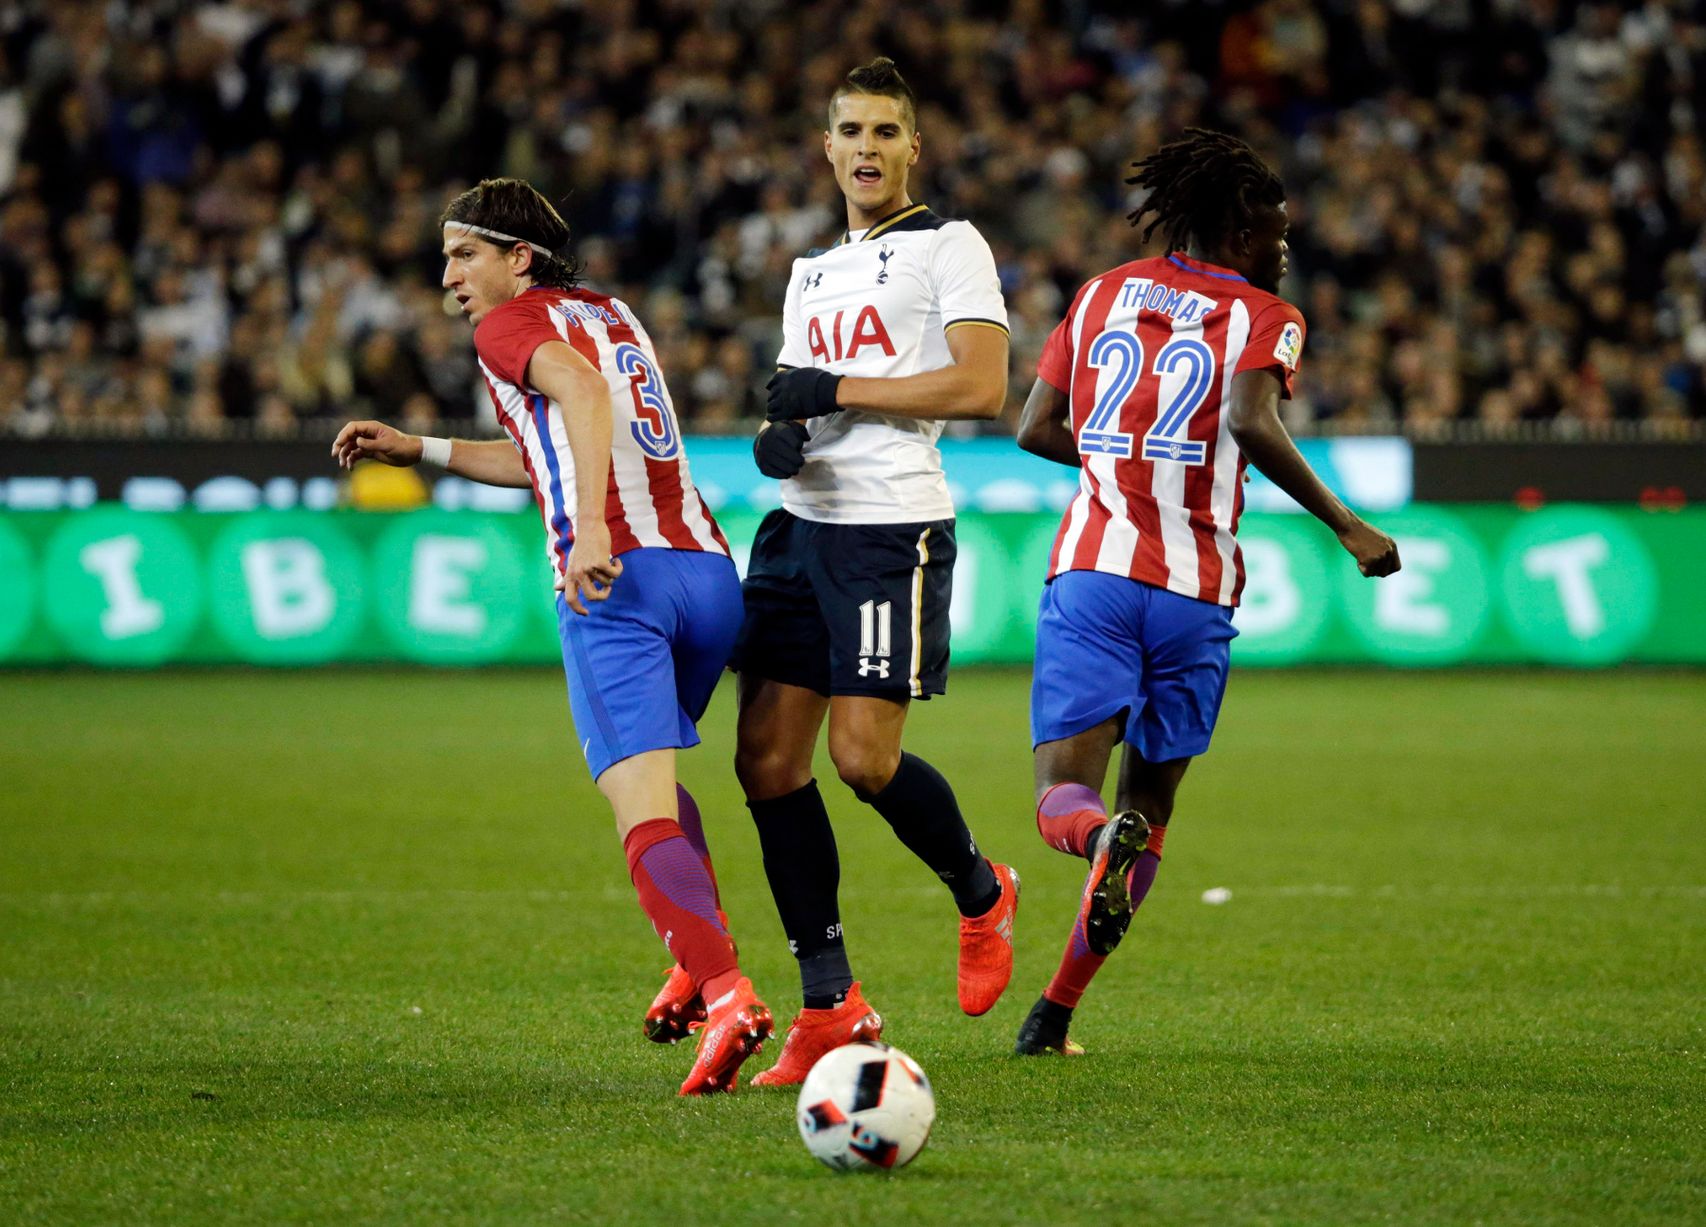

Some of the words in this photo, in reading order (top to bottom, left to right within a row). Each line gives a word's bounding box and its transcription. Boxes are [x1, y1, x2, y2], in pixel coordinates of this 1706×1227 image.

[808, 304, 897, 364] AIA
[616, 342, 678, 461] 3
[1079, 330, 1216, 466] 22
[858, 600, 892, 656] 11
